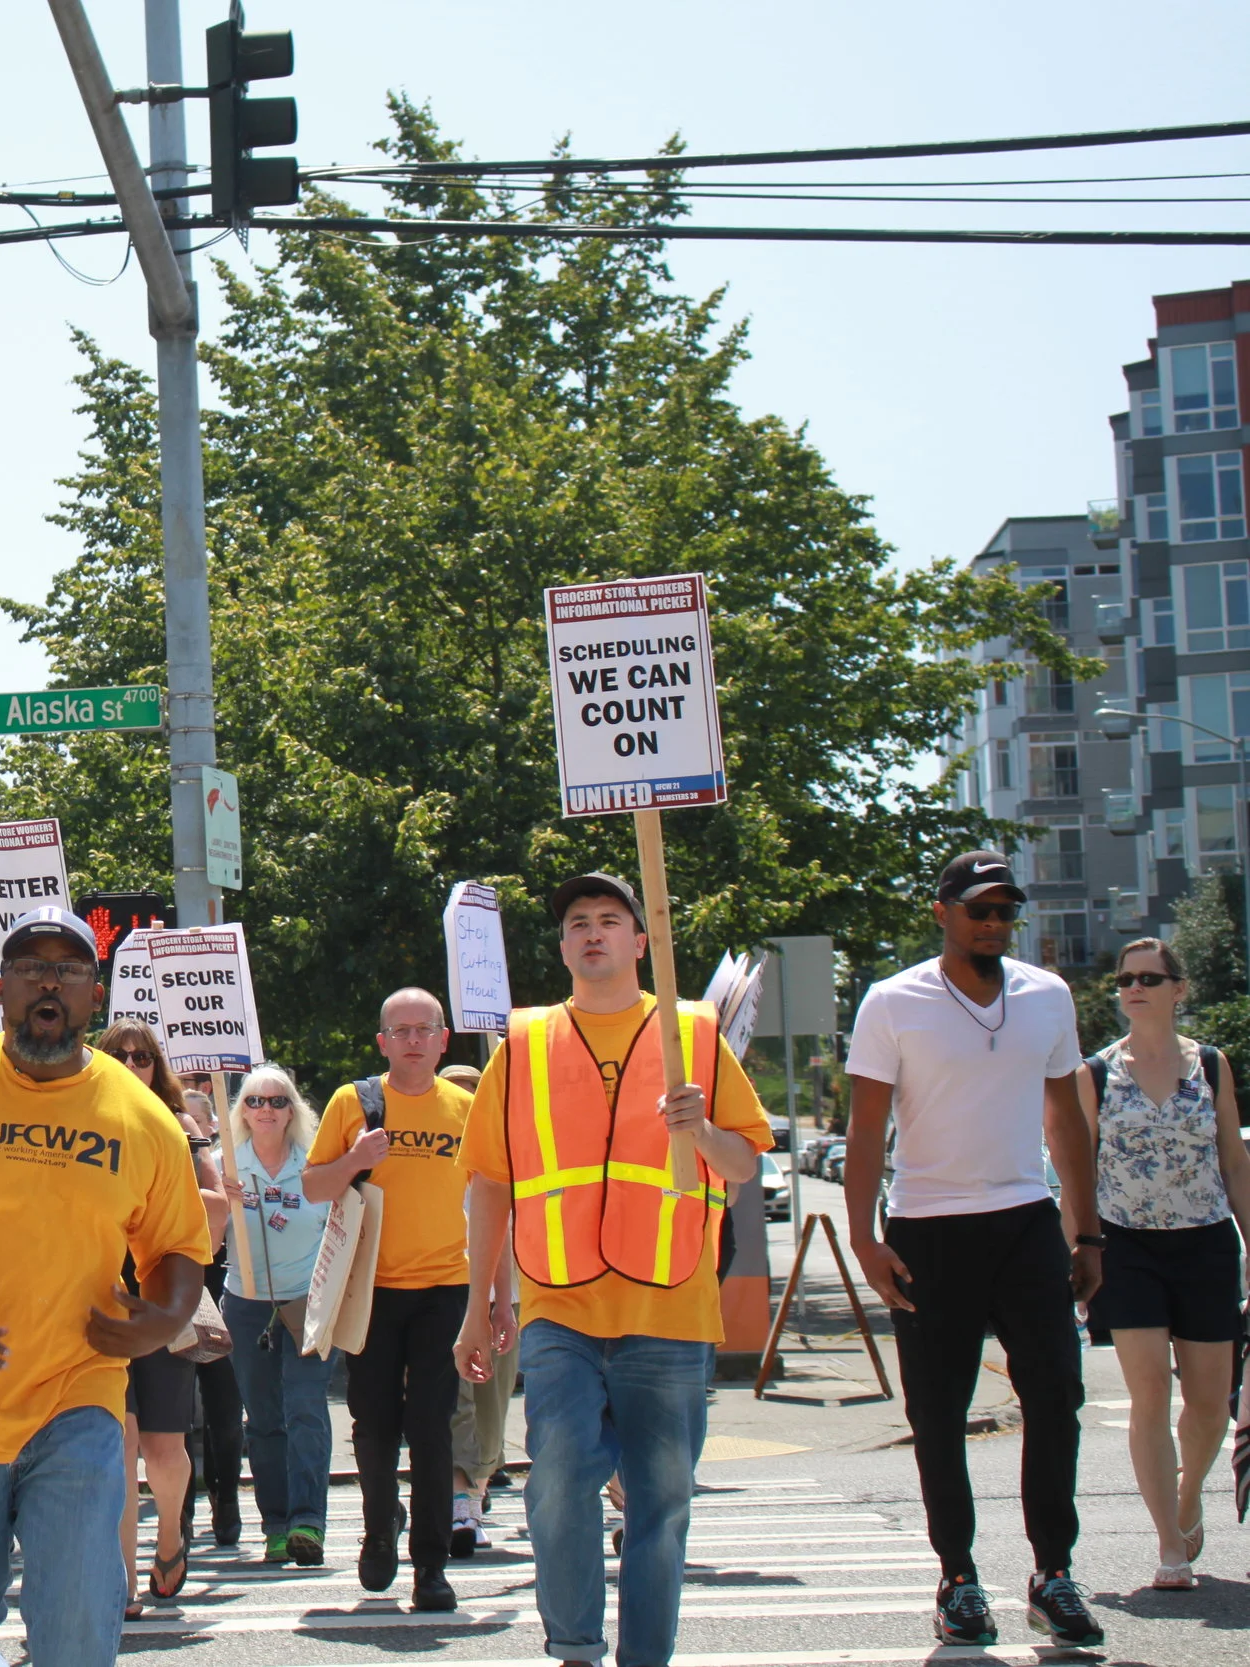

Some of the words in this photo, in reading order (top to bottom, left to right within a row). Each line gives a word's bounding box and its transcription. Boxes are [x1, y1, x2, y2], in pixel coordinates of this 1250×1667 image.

[554, 589, 603, 604] GROCERY
[604, 585, 637, 600] STORE
[638, 581, 692, 597] WORKERS
[555, 599, 649, 619] INFORMATIONAL
[651, 595, 692, 611] PICKET
[558, 635, 696, 662] SCHEDULING
[568, 667, 619, 695] WE
[627, 661, 691, 689] CAN
[6, 695, 94, 727] Alaska
[101, 700, 124, 722] St
[123, 689, 157, 704] 4700
[581, 696, 685, 727] COUNT
[613, 731, 658, 757] ON
[569, 782, 652, 812] UNITED
[656, 792, 688, 801] TEAMSTERS
[16, 823, 54, 835] WORKERS
[26, 833, 55, 845] PICKET
[151, 937, 182, 947] GROCERY
[182, 936, 203, 944] STORE
[204, 934, 234, 943] WORKERS
[153, 944, 211, 957] INFORMATIONAL
[211, 943, 235, 952] PICKET
[119, 965, 152, 979] SEC
[161, 970, 235, 988] SECURE
[134, 988, 156, 1002] OU
[184, 995, 224, 1011] OUR
[113, 1011, 159, 1025] PENS
[463, 1011, 497, 1030] UNITED
[167, 1021, 245, 1039] PENSION
[171, 1055, 222, 1073] UNITED
[385, 1129, 435, 1148] FCW
[4, 1146, 38, 1157] working
[39, 1150, 74, 1160] America
[75, 1131, 122, 1173] 21
